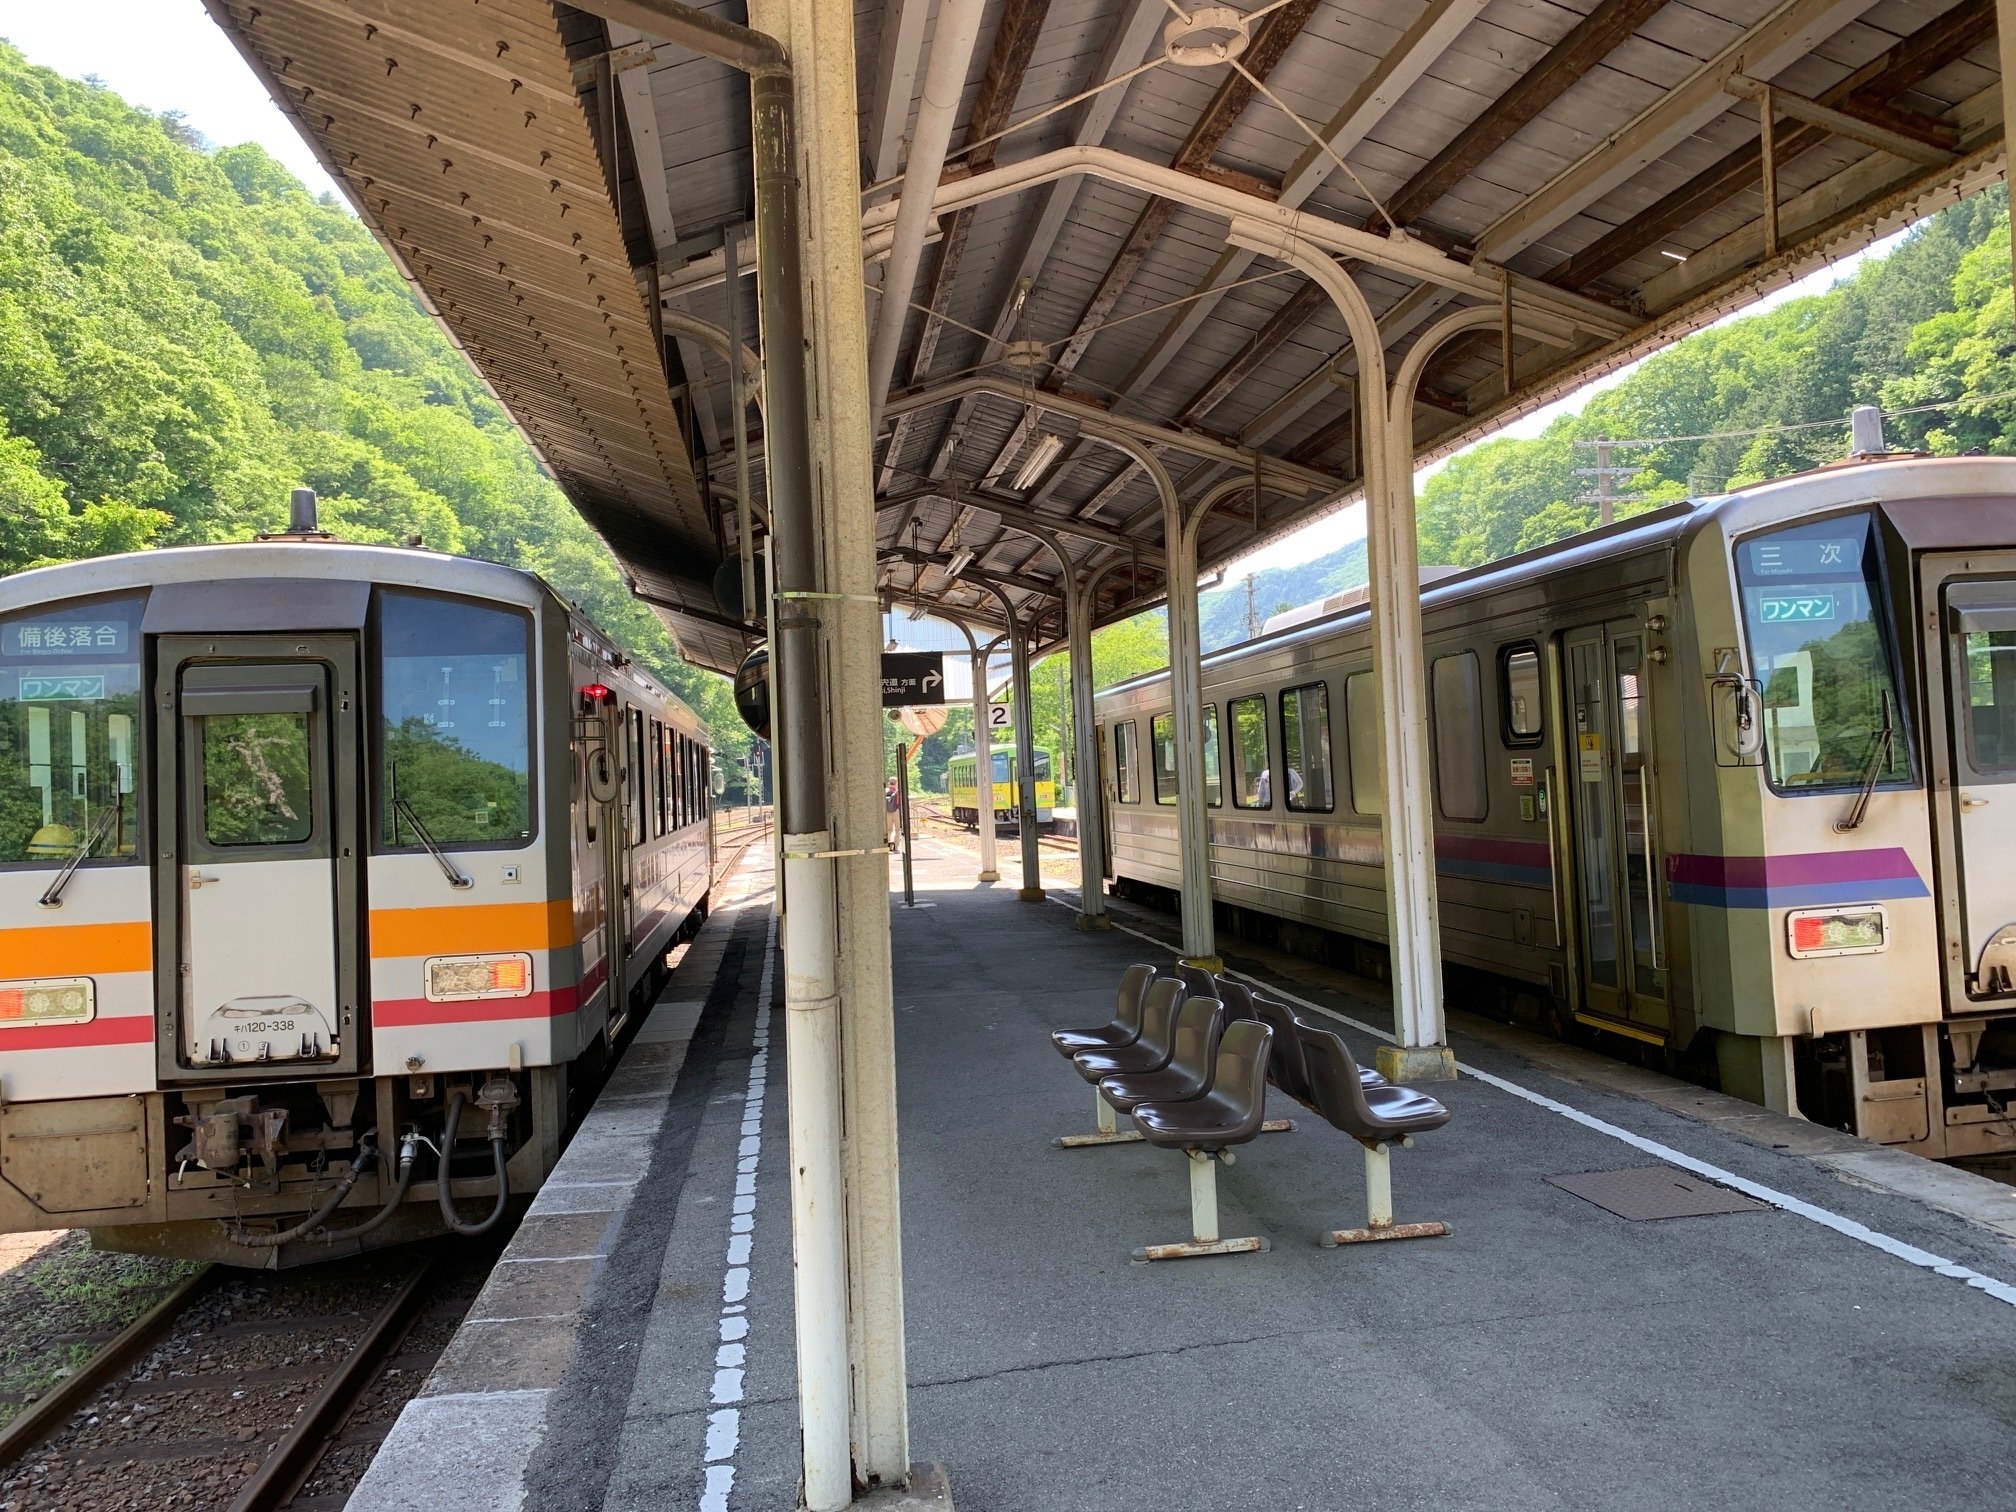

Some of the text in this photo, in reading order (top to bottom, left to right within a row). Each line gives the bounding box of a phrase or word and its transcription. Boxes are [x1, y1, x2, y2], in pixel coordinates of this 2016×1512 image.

[1763, 599, 1831, 619] ワンマン
[18, 625, 118, 648] 備後落合
[23, 679, 101, 698] ワンマン
[991, 707, 1007, 724] 2
[233, 1020, 295, 1033] キハ120-338
